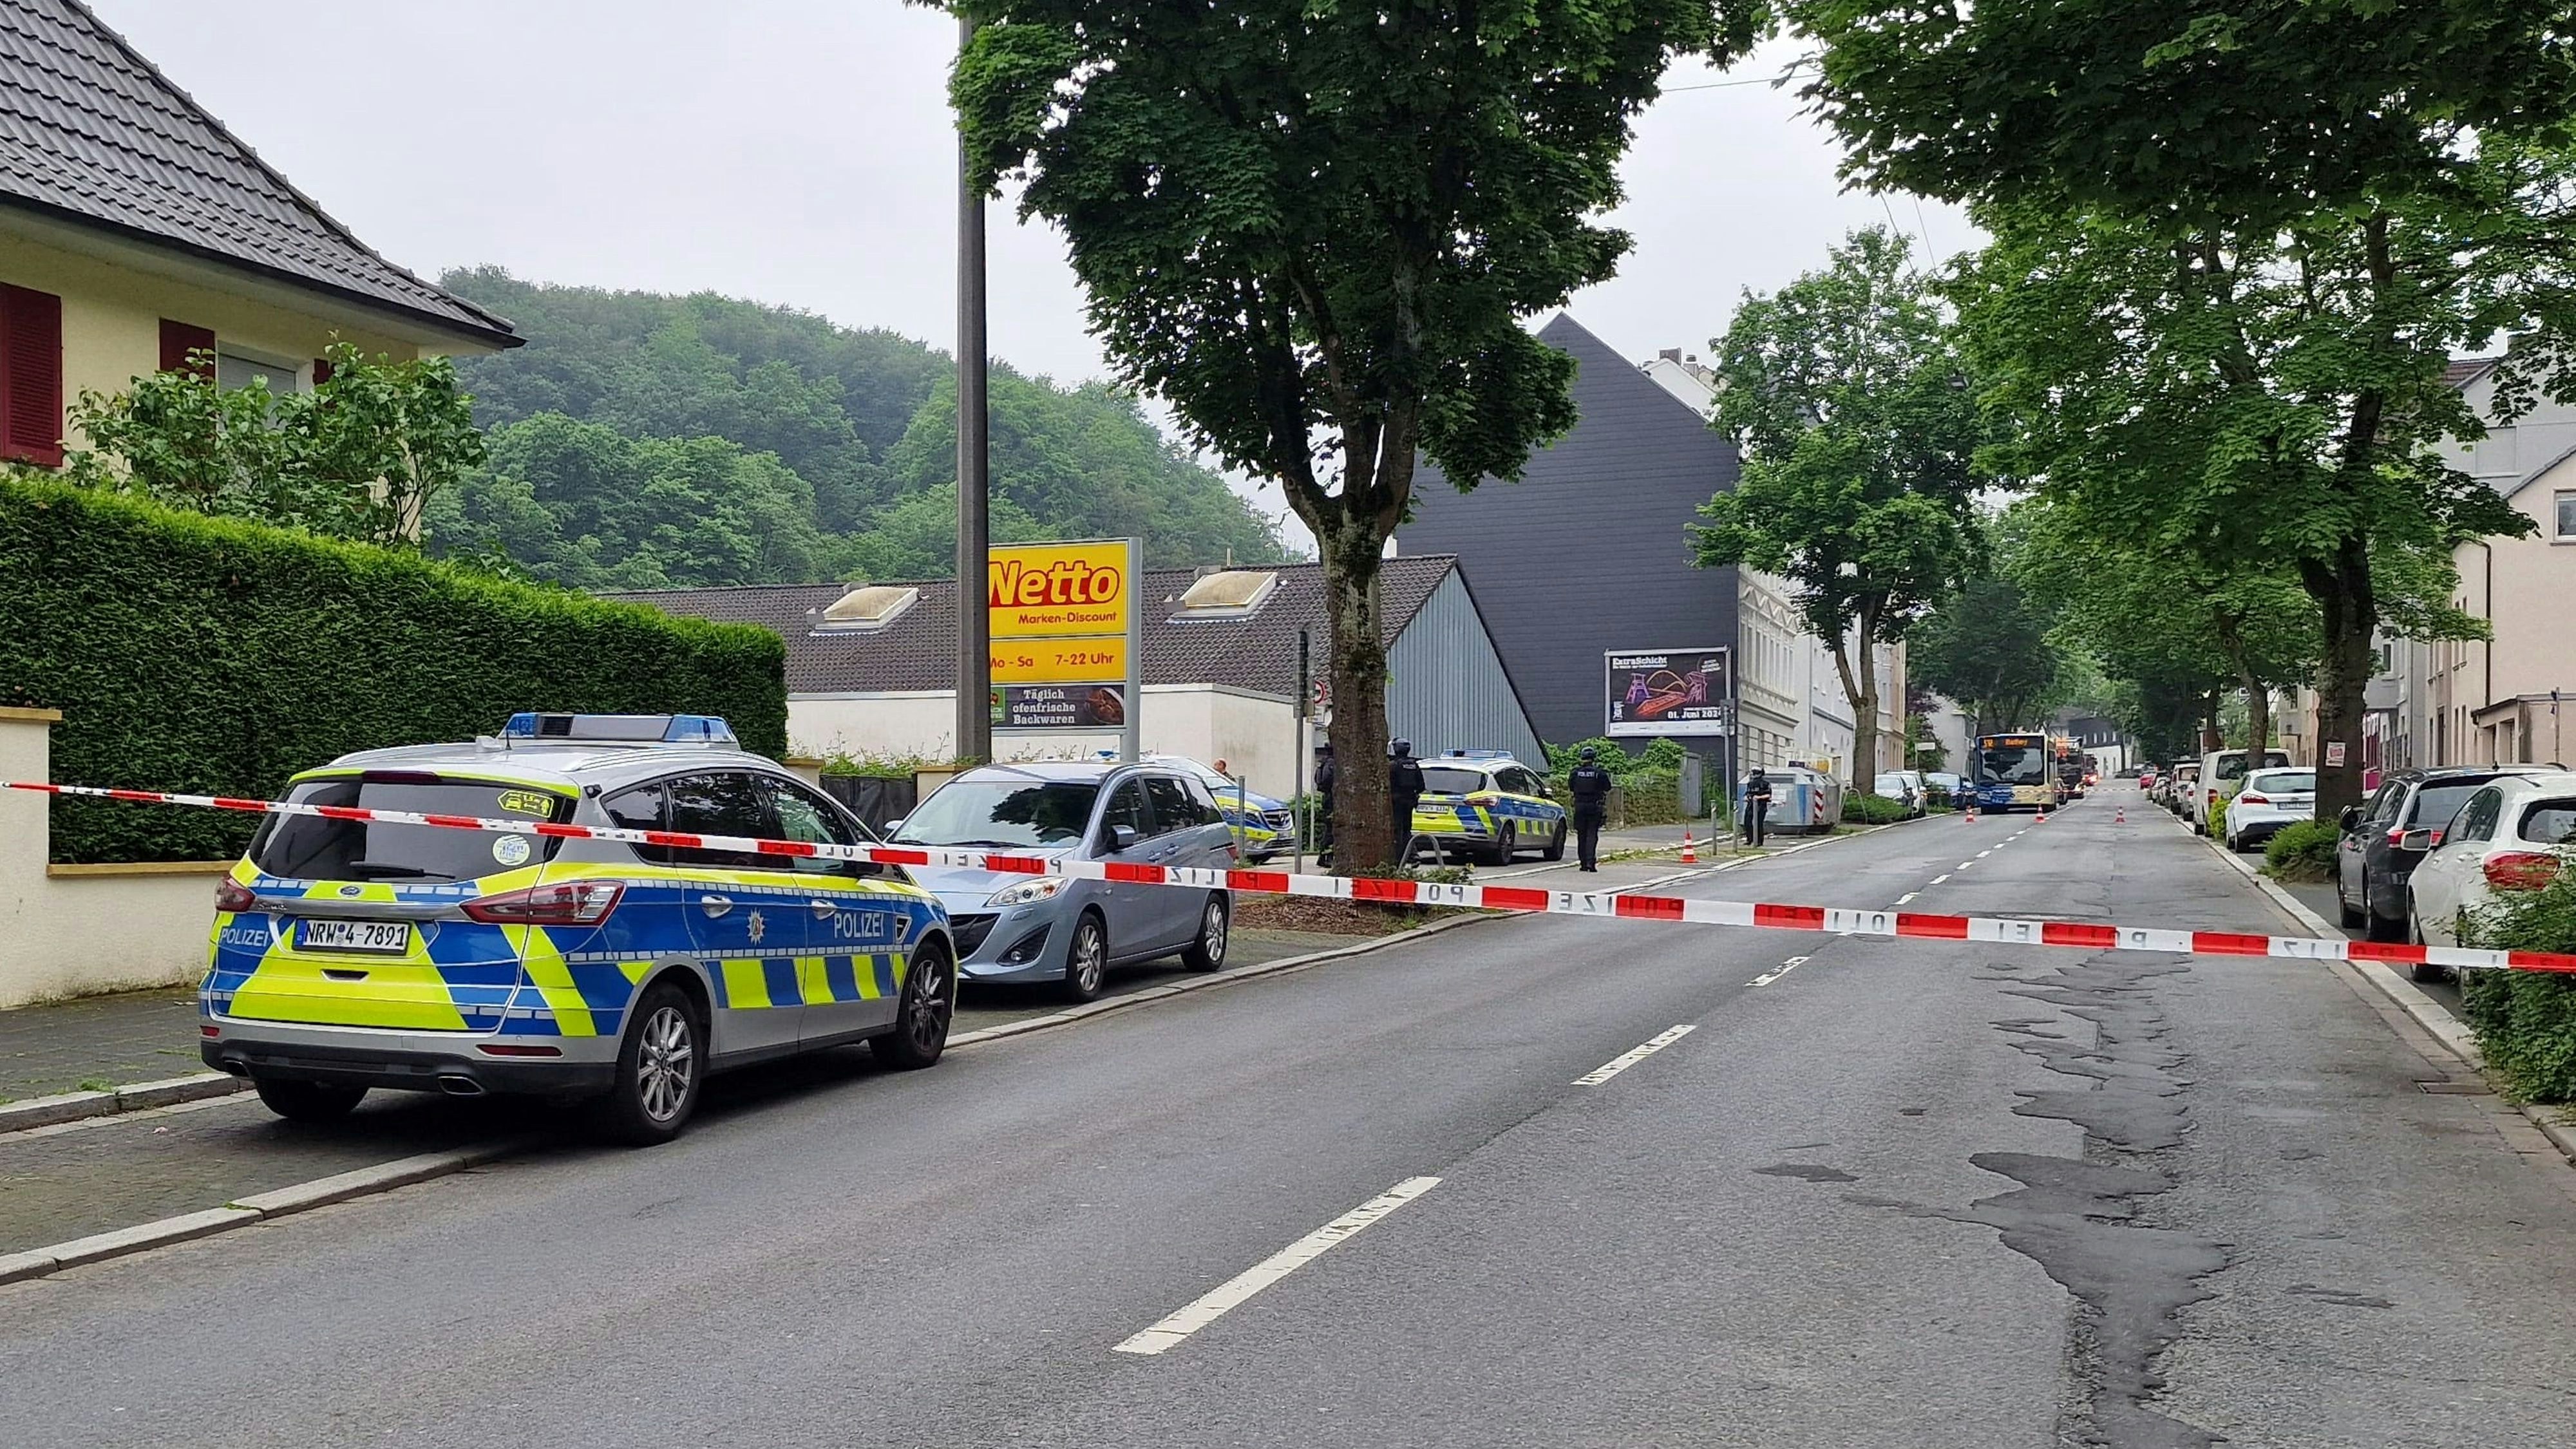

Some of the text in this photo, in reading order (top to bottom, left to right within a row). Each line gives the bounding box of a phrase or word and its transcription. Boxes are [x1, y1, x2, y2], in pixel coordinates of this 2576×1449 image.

[989, 560, 1119, 607] Netto
[1018, 611, 1117, 625] Marken-Discount
[1018, 656, 1034, 667] Sa
[1056, 653, 1086, 665] 7-22
[1090, 652, 1114, 665] Uhr
[1613, 656, 1667, 665] ExtraSchicht
[1023, 688, 1065, 701] Täglich
[1012, 702, 1075, 713] ofenfrische
[1681, 710, 1700, 719] Juni
[1014, 714, 1075, 724] Backwaren
[834, 912, 884, 939] POLIZEI
[220, 927, 269, 947] POLIZEI
[306, 922, 336, 944] NRW
[346, 923, 406, 947] 4-7891
